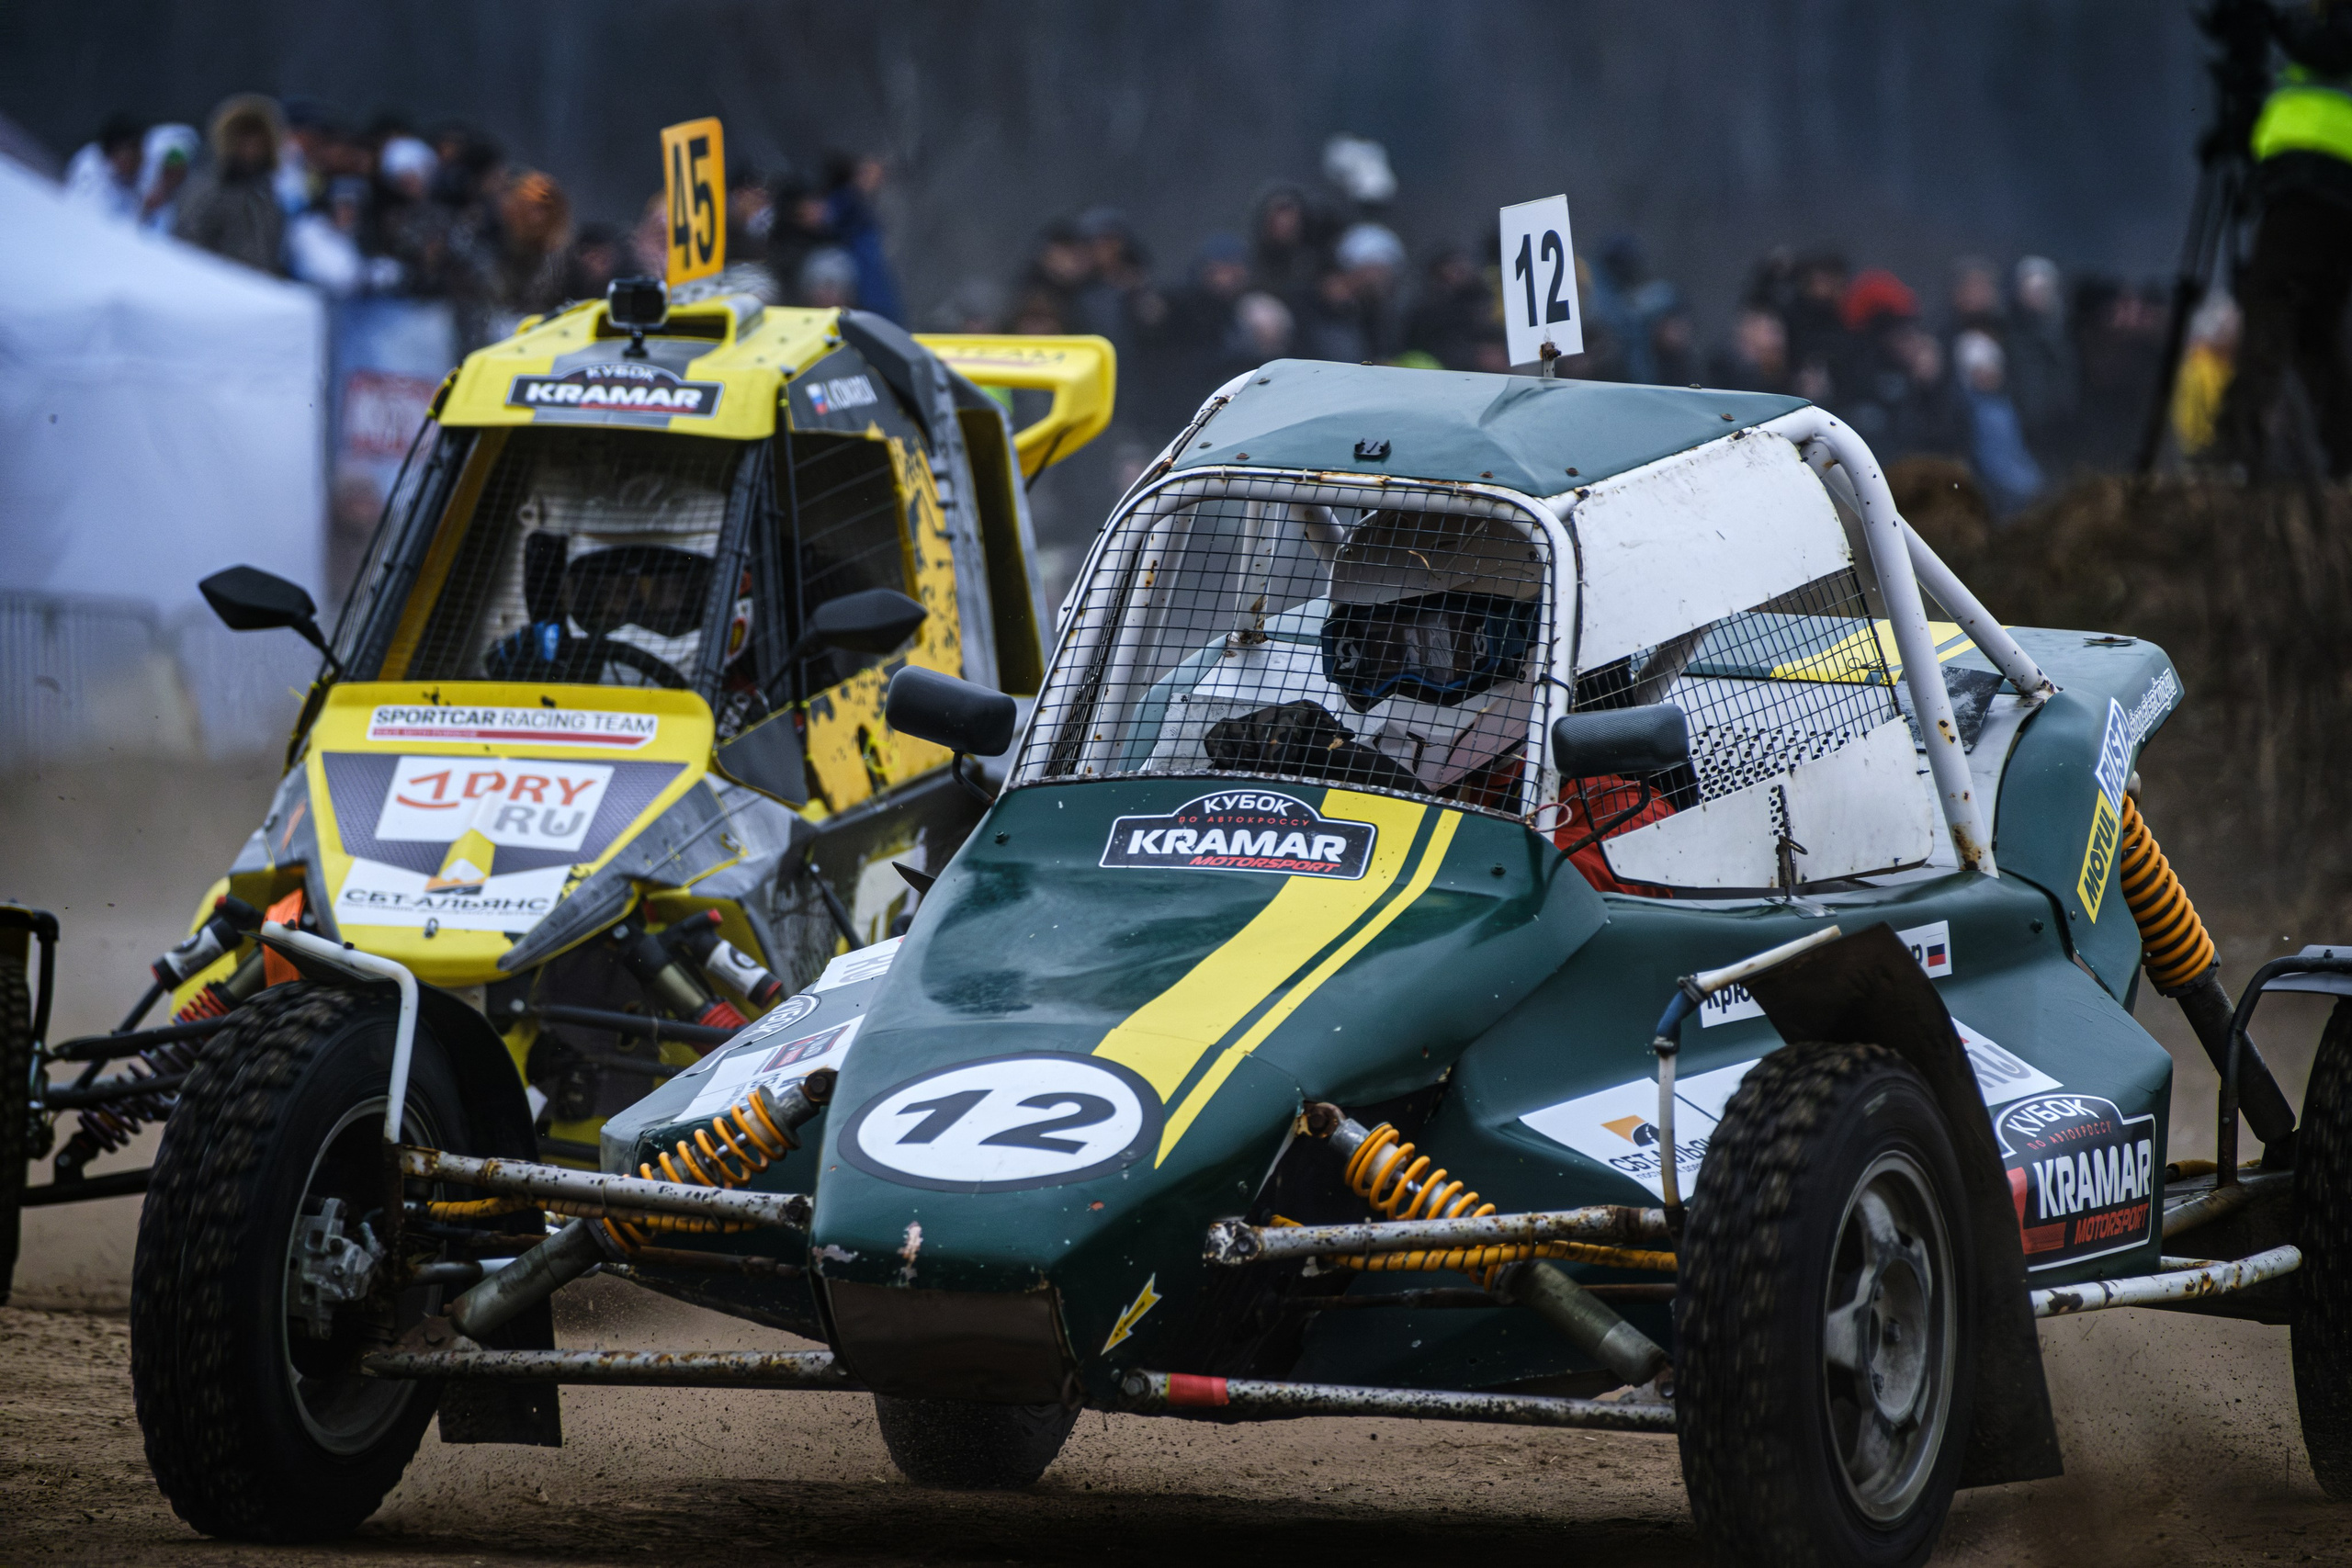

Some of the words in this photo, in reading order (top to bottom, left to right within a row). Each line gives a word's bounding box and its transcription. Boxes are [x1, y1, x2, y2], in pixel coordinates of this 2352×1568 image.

[673, 136, 716, 269] 45
[1515, 230, 1570, 327] 12
[525, 382, 703, 408] KRAMAR
[375, 707, 495, 726] SPORTCAR
[502, 710, 588, 729] RACING
[589, 714, 655, 734] TEAM
[492, 805, 586, 838] RU
[1178, 816, 1198, 824] ПО
[1207, 816, 1311, 827] АВТОКРОССУ
[1204, 794, 1295, 817] КУБОК
[1126, 828, 1348, 863] KRAMAR
[2083, 805, 2117, 911] MOTUL
[1188, 855, 1341, 874] MOTORSPORT
[894, 1089, 1117, 1156] 12
[2006, 1099, 2100, 1138] КУБОК
[2026, 1138, 2047, 1151] ПО
[2049, 1121, 2113, 1145] АВТОКРОССУ
[2032, 1138, 2153, 1220] KRAMAR
[2074, 1202, 2150, 1246] MOTORSPORT
